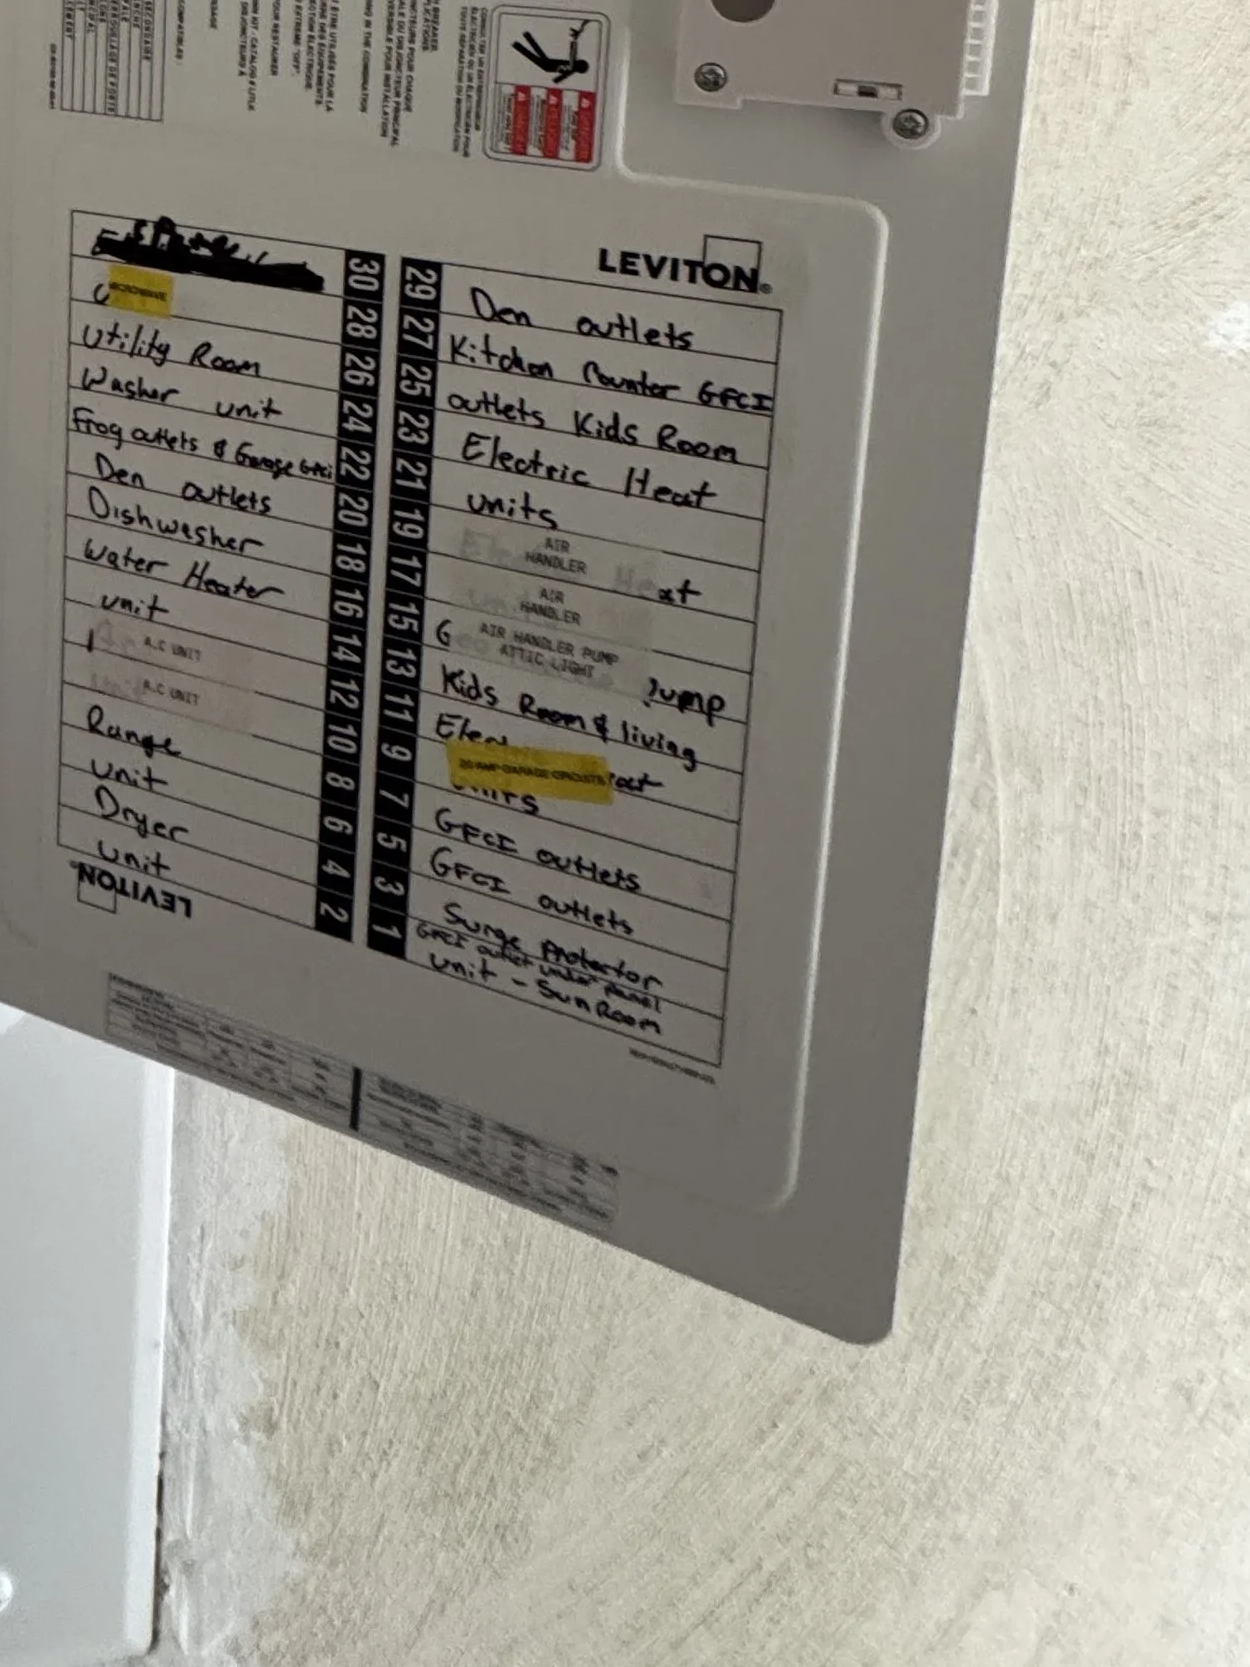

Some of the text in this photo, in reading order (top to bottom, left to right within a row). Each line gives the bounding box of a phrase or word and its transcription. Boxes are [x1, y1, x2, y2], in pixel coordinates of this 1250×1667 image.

[348, 257, 382, 292] 30
[404, 266, 438, 302] 29
[599, 247, 760, 294] LEVITON
[345, 303, 379, 340] 28
[401, 315, 435, 351] 27
[470, 286, 695, 352] Den outlets
[81, 322, 261, 378] Utility Room
[343, 352, 377, 386] 26
[399, 362, 433, 398] 25
[450, 334, 554, 379] Kitchen
[698, 380, 774, 413] GFCI
[81, 366, 283, 419] Washer unit
[341, 399, 374, 434] 24
[397, 411, 430, 445] 23
[447, 391, 741, 465] outlets Kids Room
[339, 446, 371, 482] 22
[394, 458, 428, 494] 21
[461, 431, 719, 510] Electric Heat
[95, 452, 273, 516] Den outlets
[337, 491, 370, 528] 20
[391, 509, 424, 540] 19
[467, 491, 560, 530] units
[335, 543, 367, 574] 18
[544, 537, 571, 553] AIR
[84, 538, 286, 600] Water Heater
[389, 555, 423, 588] 17
[525, 551, 588, 576] HANDLER
[101, 593, 170, 620] unit
[333, 588, 364, 619] 16
[519, 601, 582, 626] HANDLER
[539, 589, 566, 605] AIR
[387, 601, 419, 632] 15
[171, 643, 202, 662] UNIT
[331, 633, 362, 665] 14
[479, 622, 620, 667] AIR HANDLER PUMP
[500, 644, 596, 679] ATTIC LIGHT
[385, 647, 417, 679] 13
[170, 686, 199, 707] UNIT
[329, 678, 361, 710] 12
[383, 694, 415, 724] 11
[87, 704, 182, 757] Range
[441, 662, 500, 707] Kids
[519, 692, 587, 732] Room
[622, 720, 698, 773] living
[327, 724, 358, 755] 10
[380, 742, 412, 762] 9
[91, 758, 169, 787] unit
[324, 771, 356, 791] 8
[95, 785, 190, 839] Dryer
[379, 786, 410, 809] 7
[322, 815, 354, 835] 6
[98, 839, 171, 875] unit
[376, 832, 407, 853] 5
[434, 806, 642, 894] GFCI outlets
[321, 859, 352, 880] 4
[373, 875, 405, 897] 3
[76, 861, 193, 918] LEVITON
[429, 845, 636, 936] GFCI outlets
[319, 902, 350, 924] 2
[443, 902, 521, 952] Surge
[371, 922, 402, 940] 1
